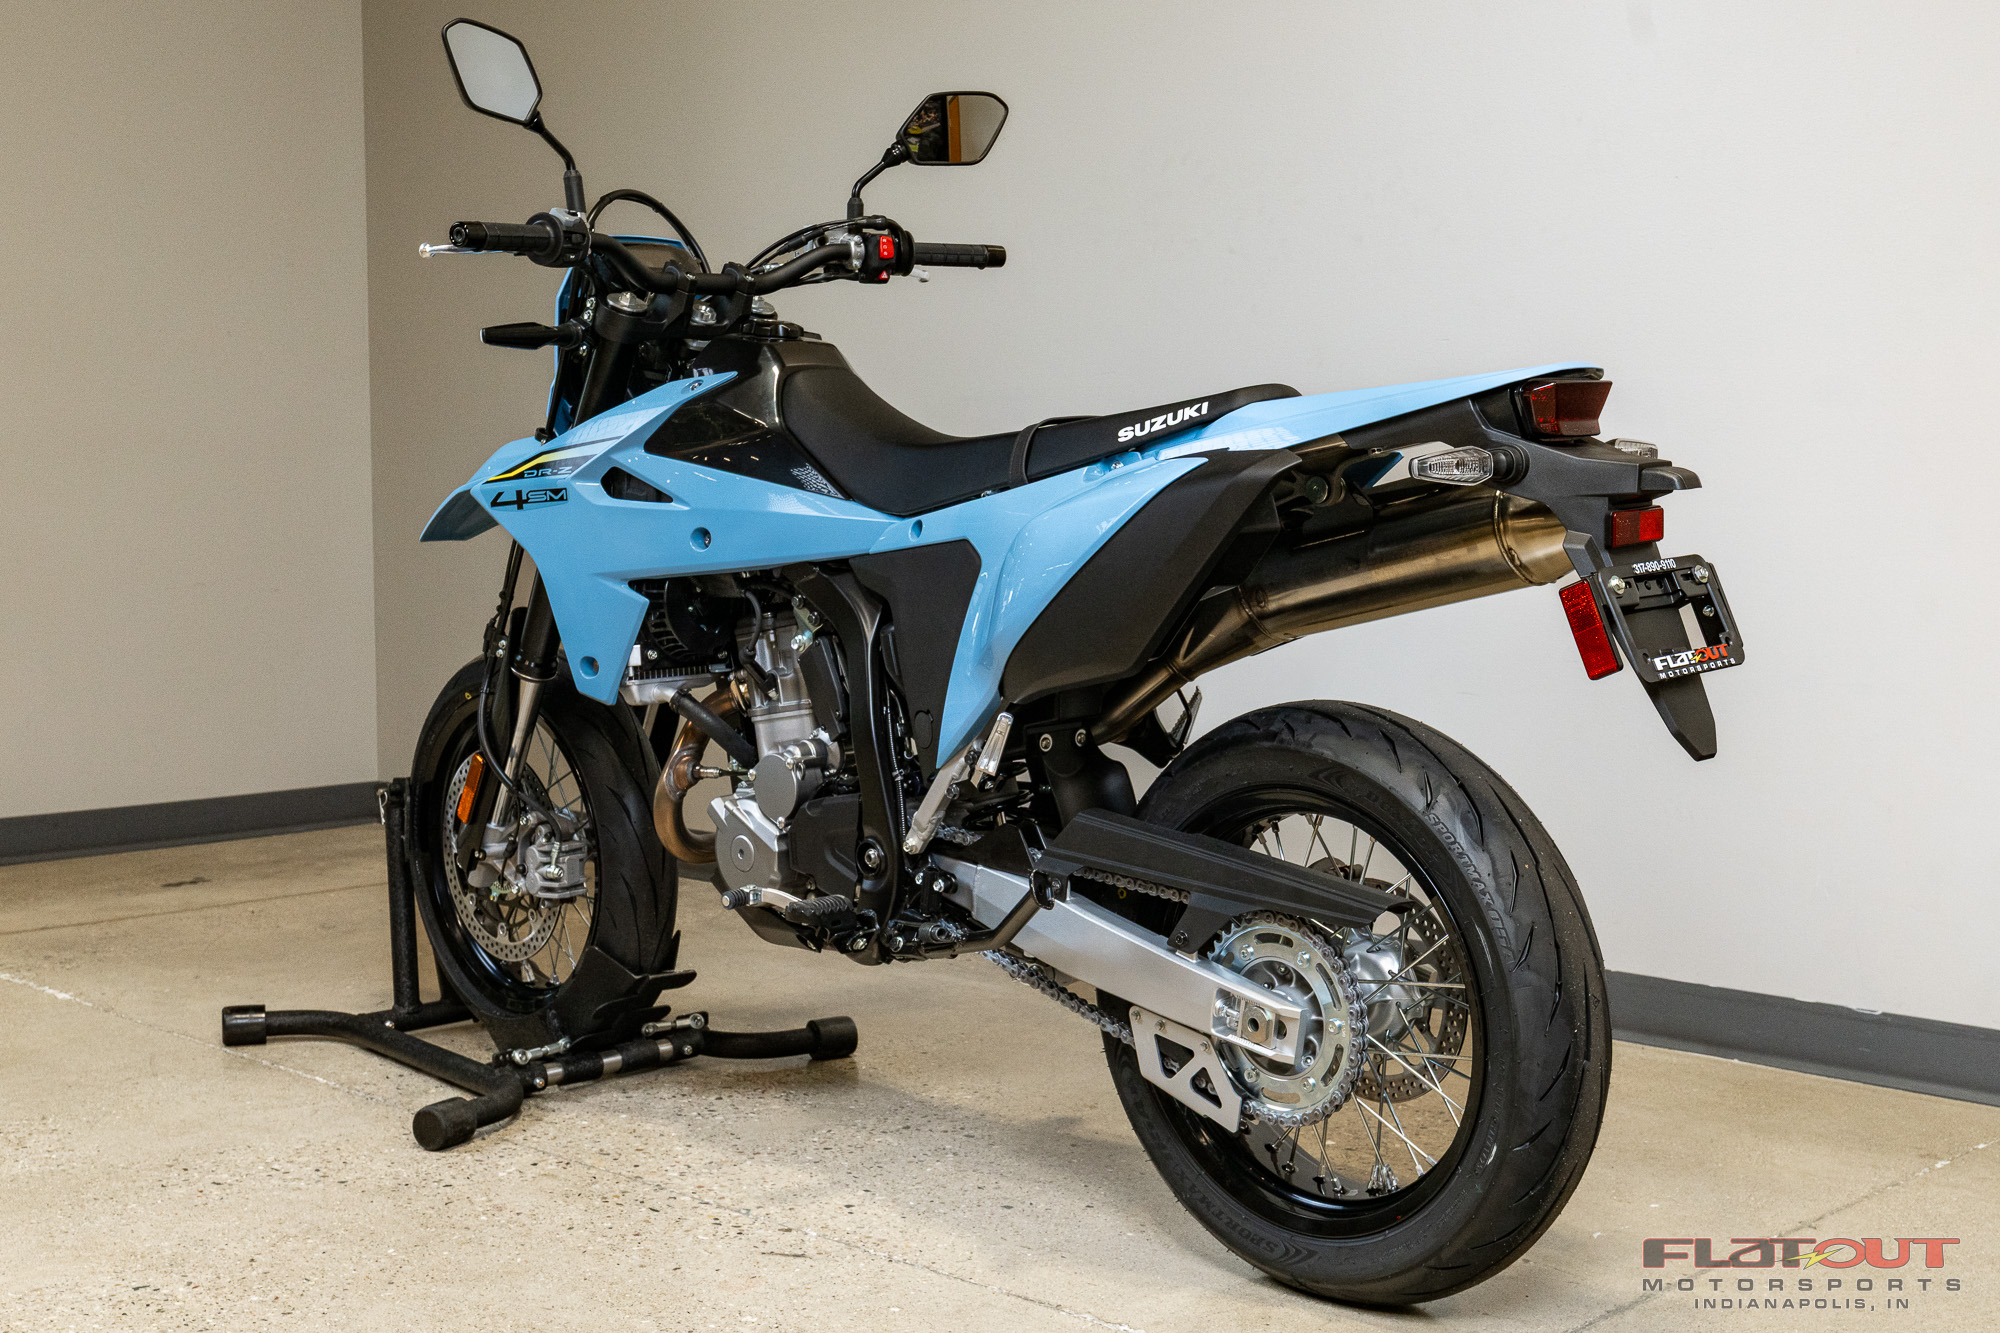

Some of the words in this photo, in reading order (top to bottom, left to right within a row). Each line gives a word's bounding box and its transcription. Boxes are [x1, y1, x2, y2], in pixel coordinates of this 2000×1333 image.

[1117, 401, 1209, 443] SUZUKI
[523, 466, 573, 478] DR-Z
[1632, 558, 1677, 574] 317-890-9110
[1658, 657, 1736, 679] MOTORSPORTS
[1425, 811, 1496, 907] SPORTMAX
